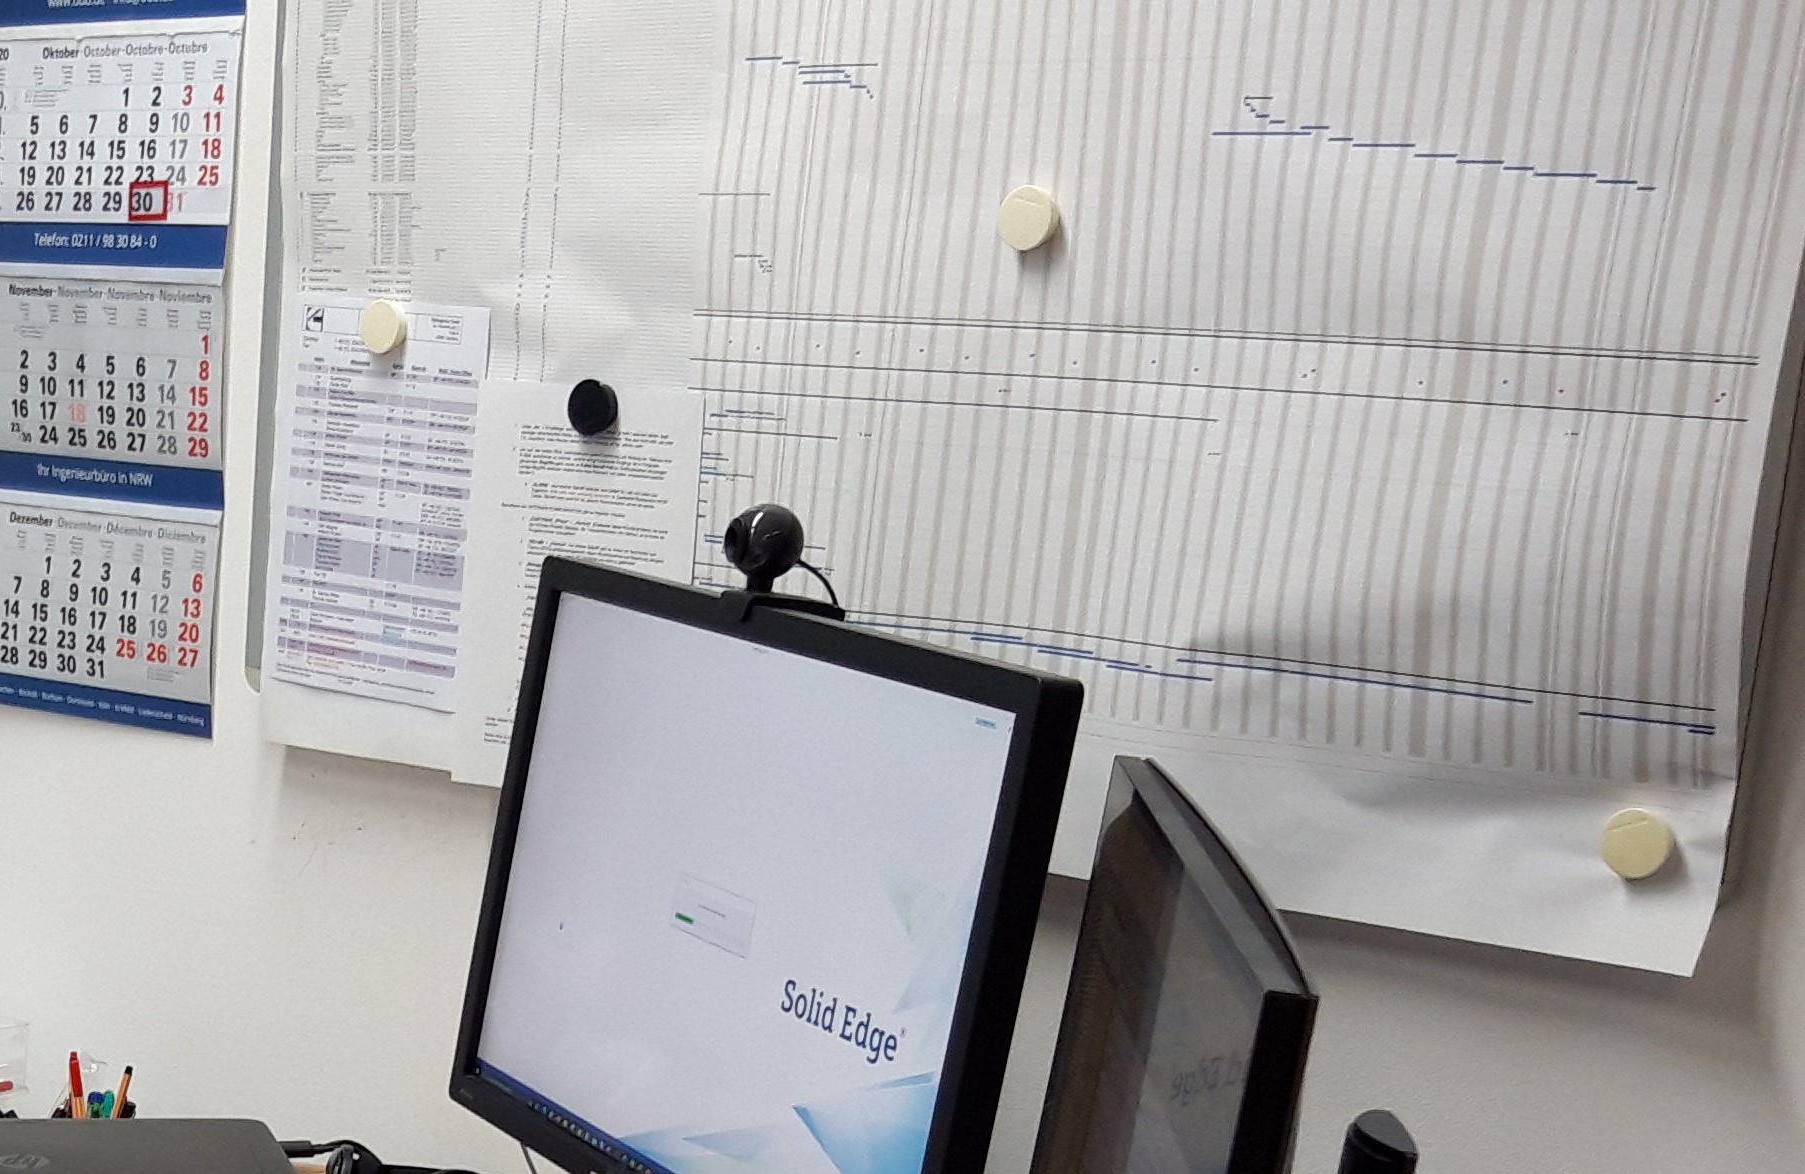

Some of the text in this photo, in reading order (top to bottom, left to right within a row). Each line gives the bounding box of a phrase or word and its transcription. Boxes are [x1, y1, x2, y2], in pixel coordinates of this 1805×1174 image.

[42, 47, 79, 60] Oktober
[122, 88, 129, 107] 1
[152, 86, 161, 106] 2
[182, 85, 192, 105] 3
[213, 84, 224, 104] 4
[30, 116, 39, 134] 5
[60, 115, 68, 134] 6
[88, 114, 97, 133] 7
[118, 114, 127, 133] 8
[149, 113, 159, 133] 9
[172, 113, 189, 133] 10
[203, 112, 221, 132] 11
[21, 142, 37, 160] 12
[50, 142, 66, 160] 13
[79, 141, 95, 159] 14
[108, 140, 125, 159] 15
[139, 139, 156, 159] 16
[170, 139, 187, 159] 17
[202, 139, 221, 159] 18
[19, 167, 36, 185] 19
[46, 167, 64, 185] 20
[74, 167, 92, 185] 21
[103, 166, 123, 185] 22
[135, 166, 154, 183] 23
[166, 166, 186, 186] 24
[198, 165, 218, 186] 25
[16, 192, 34, 211] 26
[44, 192, 63, 211] 27
[73, 192, 91, 211] 28
[102, 192, 121, 212] 29
[132, 192, 152, 212] 30
[71, 234, 95, 248] 0211
[103, 235, 115, 248] 98
[117, 235, 129, 248] 30
[131, 236, 143, 248] 84
[9, 285, 53, 297] November
[202, 335, 209, 354] 1
[20, 350, 28, 369] 2
[48, 352, 57, 371] 3
[76, 354, 85, 372] 4
[106, 356, 115, 375] 5
[136, 357, 145, 377] 6
[167, 360, 177, 379] 7
[199, 360, 209, 380] 8
[19, 375, 28, 393] 9
[40, 376, 56, 395] 10
[68, 379, 85, 397] 11
[98, 381, 115, 400] 12
[127, 383, 145, 402] 13
[158, 384, 176, 404] 14
[189, 387, 208, 407] 15
[12, 399, 28, 418] 16
[40, 401, 56, 420] 17
[98, 406, 115, 425] 19
[126, 408, 145, 427] 20
[156, 410, 175, 430] 21
[187, 412, 208, 432] 22
[40, 425, 58, 445] 24
[68, 428, 87, 447] 25
[97, 430, 116, 449] 26
[127, 433, 145, 452] 27
[157, 435, 177, 454] 28
[188, 438, 208, 458] 29
[52, 465, 116, 484] Ingenieurbüro
[129, 472, 152, 486] NRW
[10, 512, 53, 527] Dezember
[45, 556, 51, 574] 1
[72, 559, 81, 578] 2
[101, 563, 110, 581] 3
[131, 567, 141, 586] 4
[162, 570, 171, 589] 5
[193, 573, 202, 592] 6
[14, 576, 22, 594] 7
[40, 580, 49, 598] 8
[69, 584, 78, 602] 9
[91, 587, 108, 606] 10
[121, 591, 137, 610] 11
[151, 595, 168, 614] 12
[182, 599, 201, 618] 13
[4, 600, 19, 618] 14
[32, 604, 48, 622] 15
[60, 607, 76, 626] 16
[90, 611, 106, 630] 17
[119, 615, 136, 635] 18
[149, 619, 167, 639] 19
[179, 623, 199, 643] 20
[1, 623, 18, 641] 21
[28, 627, 46, 645] 22
[58, 631, 75, 650] 23
[86, 635, 105, 655] 24
[116, 639, 136, 658] 25
[147, 643, 167, 663] 26
[178, 648, 198, 668] 27
[1, 645, 18, 664] 28
[28, 650, 46, 669] 29
[57, 655, 76, 674] 30
[86, 659, 104, 679] 31
[781, 979, 898, 1064] Solid Edge
